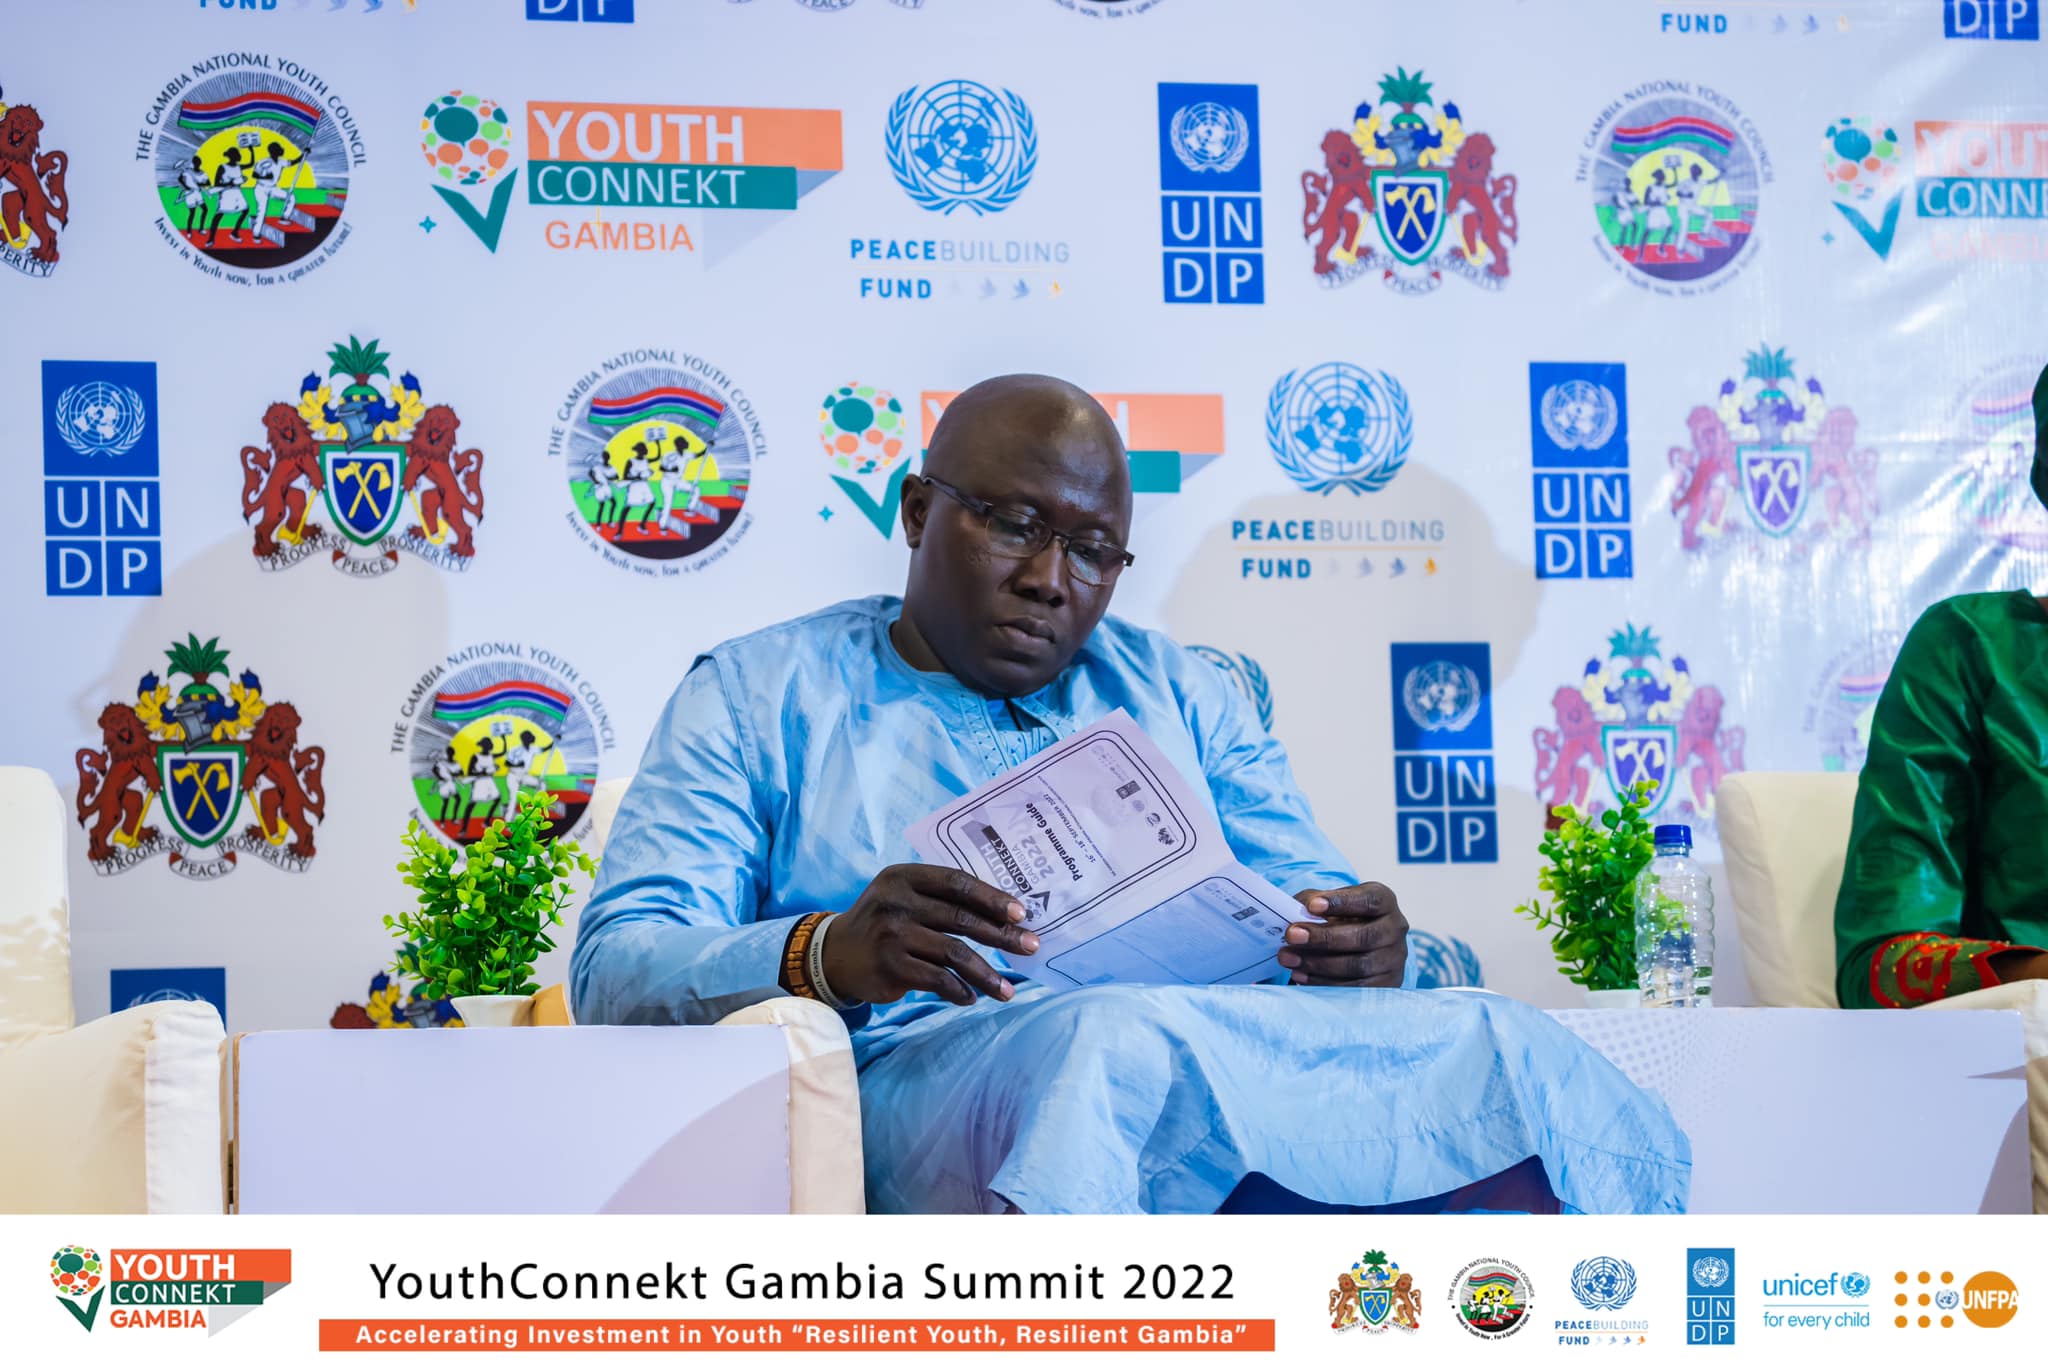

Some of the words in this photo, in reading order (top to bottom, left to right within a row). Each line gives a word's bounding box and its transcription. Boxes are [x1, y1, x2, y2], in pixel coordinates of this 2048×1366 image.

[1661, 14, 1728, 33] FUND
[136, 129, 153, 161] THE
[146, 74, 192, 125] GAMBIA
[192, 52, 271, 77] NATIONAL
[277, 57, 328, 96] YOUTH
[328, 96, 367, 168] COUNCIL
[1584, 101, 1623, 148] GAMBIA
[1624, 80, 1690, 101] NATIONAL
[1697, 86, 1740, 118] YOUTH
[532, 109, 745, 164] YOUTH
[537, 165, 745, 206] CONNEKT
[545, 220, 694, 252] GAMBIA
[860, 278, 932, 299] FUND
[548, 426, 564, 456] THE
[557, 371, 601, 421] GAMBIA
[602, 349, 676, 371] NATIONAL
[682, 353, 731, 388] YOUTH
[730, 388, 768, 459] COUNCIL
[270, 535, 347, 572] PROGRESS
[342, 559, 389, 574] PEACE
[380, 535, 467, 572] PROSPERITY
[1242, 558, 1312, 579] FUND
[391, 721, 408, 753] THE
[401, 665, 446, 717] GAMBIA
[446, 642, 522, 668] NATIONAL
[529, 647, 579, 683] YOUTH
[578, 681, 617, 751] COUNCIL
[1025, 802, 1047, 829] Guide
[1054, 806, 1078, 839] SEPTEMBER
[105, 838, 184, 875] PROGRESS
[179, 861, 227, 877] PEACE
[218, 838, 306, 873] PROSPERITY
[992, 838, 1030, 892] CONNEKT
[1012, 843, 1039, 884] GAMBIA
[1021, 835, 1055, 879] 2022
[1045, 828, 1083, 882] Programme
[811, 942, 819, 977] Gambia
